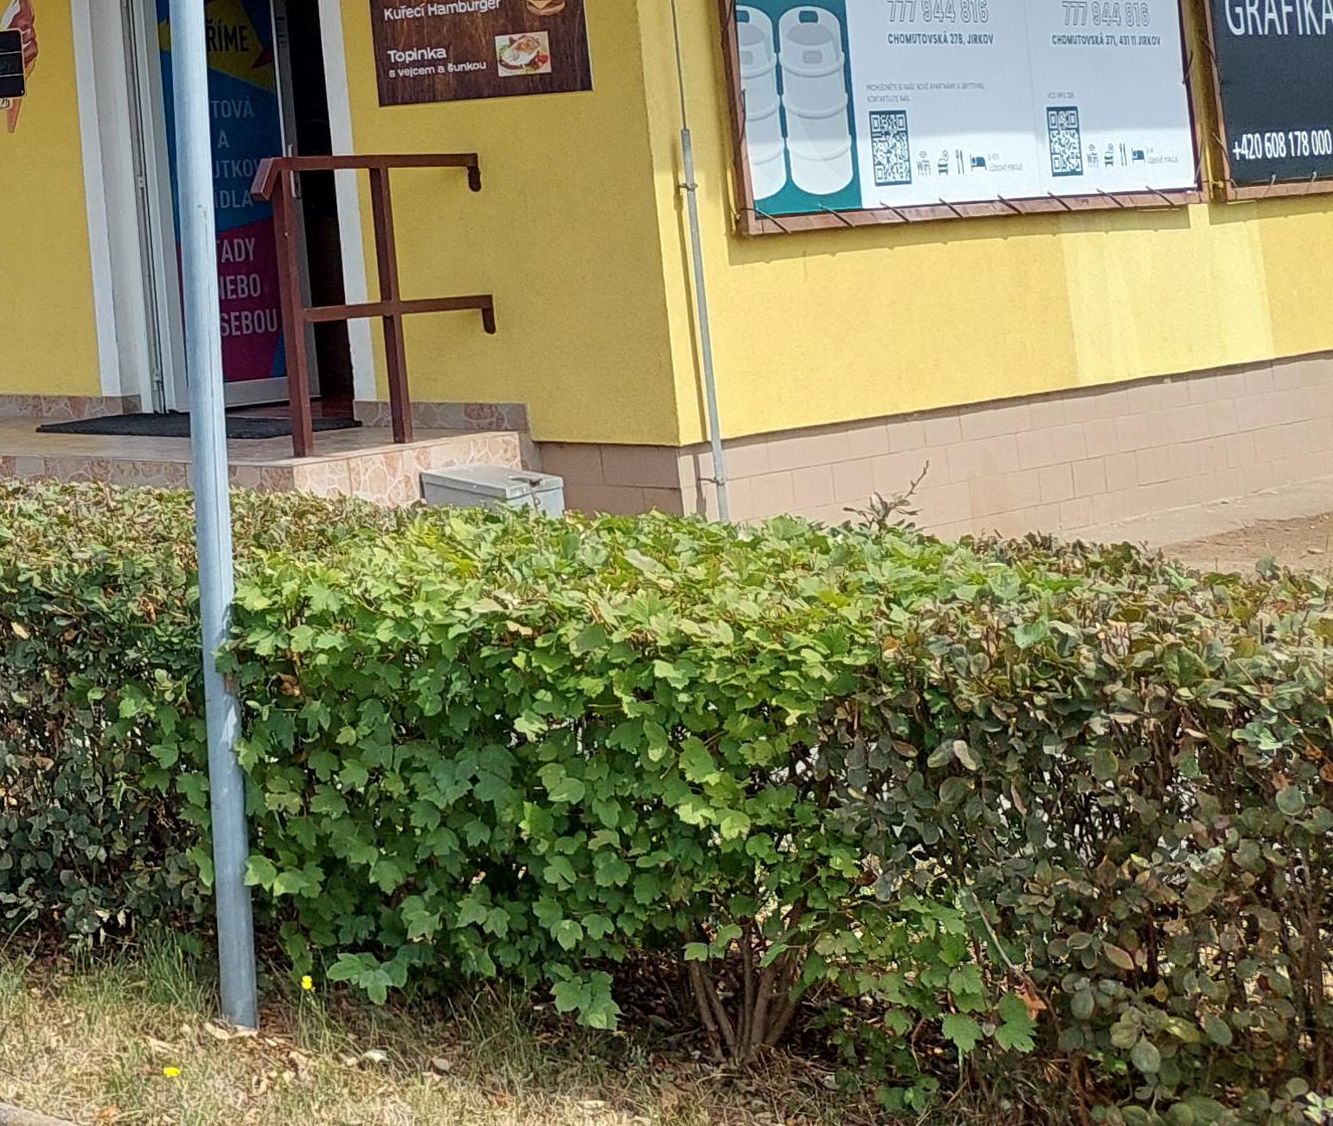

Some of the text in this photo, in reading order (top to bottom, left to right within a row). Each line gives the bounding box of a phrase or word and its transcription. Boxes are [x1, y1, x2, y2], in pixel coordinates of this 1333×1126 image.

[383, 3, 426, 22] Kuřecí
[1061, 0, 1088, 26] 777
[1091, 0, 1122, 27] 944
[205, 18, 250, 53] ŘÍME
[887, 29, 949, 45] CHOMUTOVSKÁ
[967, 33, 995, 45] JIRKOV
[1051, 31, 1104, 46] CHOMUTOVSKÁ
[387, 46, 448, 64] Topinka
[397, 64, 436, 78] vejcem
[437, 64, 446, 74] a
[447, 60, 487, 73] šunkou
[210, 95, 255, 119] TOVÁ
[217, 129, 230, 149] A
[1232, 129, 1332, 161] +420 608 178 000
[214, 185, 254, 209] ÍDLA
[217, 237, 256, 264] ADY
